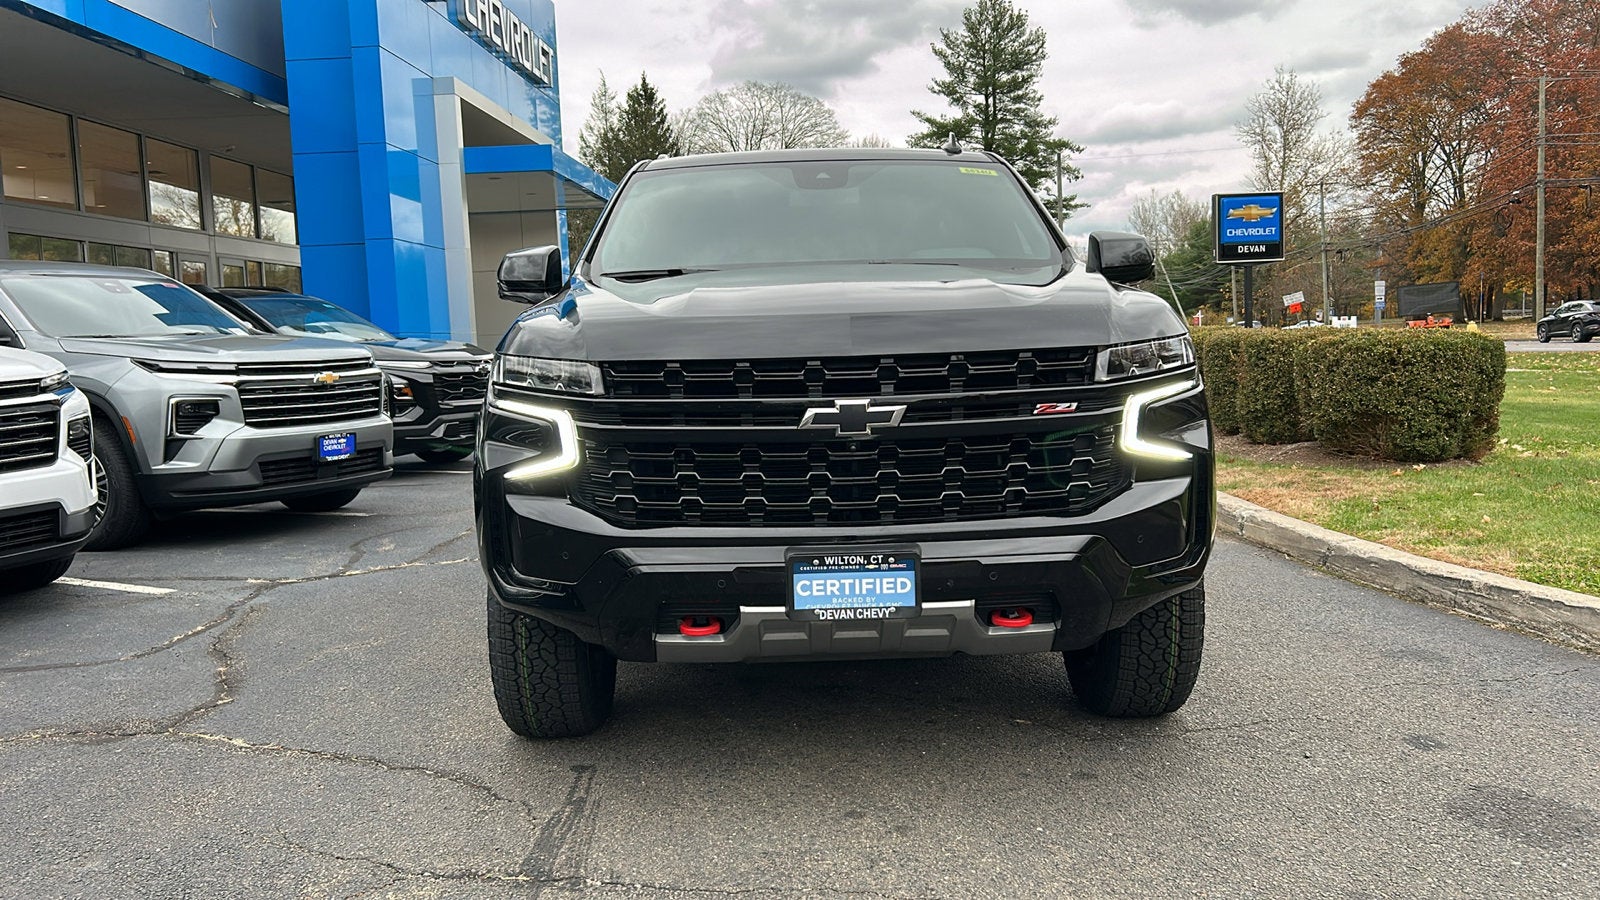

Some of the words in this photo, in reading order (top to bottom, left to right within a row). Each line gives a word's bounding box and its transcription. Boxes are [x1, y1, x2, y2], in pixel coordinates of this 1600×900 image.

[1227, 227, 1276, 237] CHEVROLET
[1238, 245, 1266, 253] DEVAN
[1033, 402, 1078, 414] Z71
[824, 556, 867, 565] WILTON,
[870, 555, 884, 564] CT
[796, 578, 912, 596] CERTIFIED
[820, 608, 854, 620] DEVAN
[856, 608, 890, 618] CHEVY
